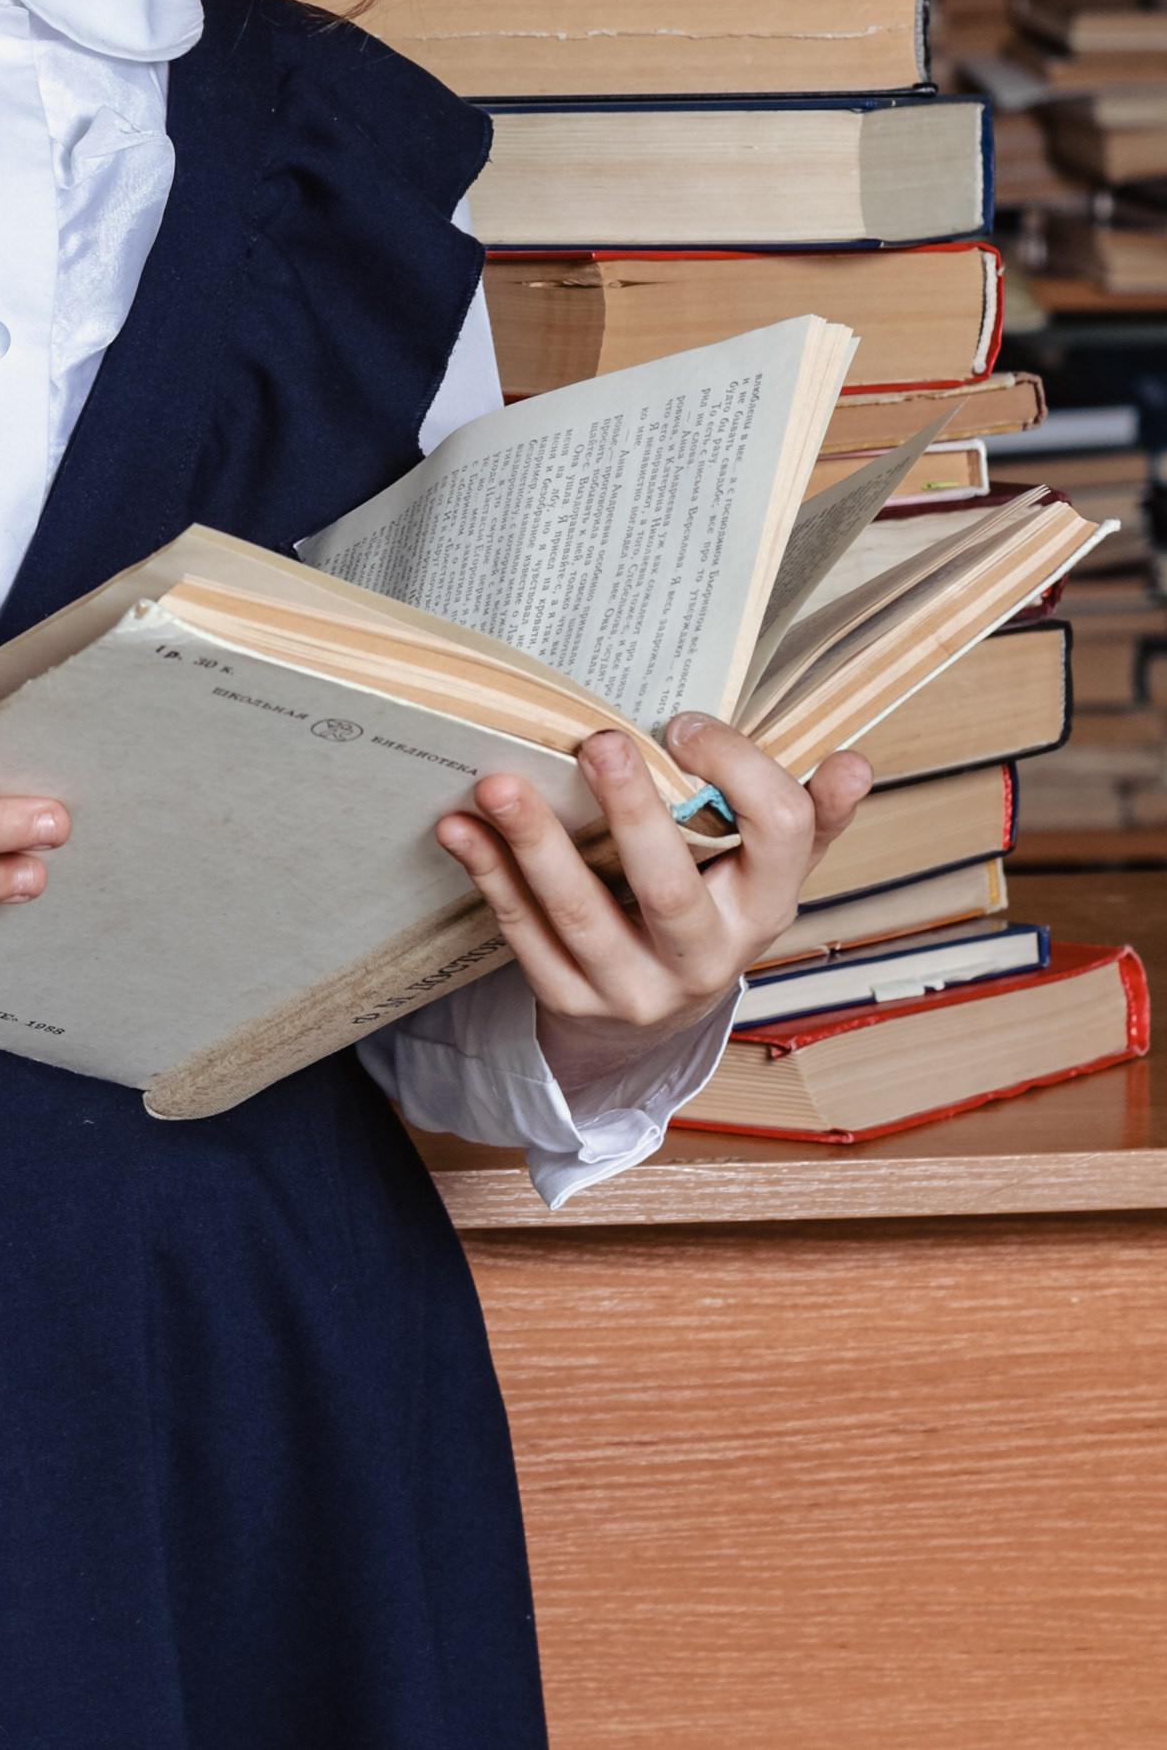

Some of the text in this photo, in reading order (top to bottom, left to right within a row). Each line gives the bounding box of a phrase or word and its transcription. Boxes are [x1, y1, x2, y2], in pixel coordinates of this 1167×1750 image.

[663, 398, 673, 418] что
[699, 387, 711, 407] рил
[709, 401, 722, 417] То
[722, 380, 739, 412] будто
[737, 391, 746, 403] не
[743, 373, 762, 429] влюблены
[639, 406, 649, 420] ко
[669, 394, 685, 439] ровича,
[695, 412, 704, 426] ни
[717, 417, 729, 432] бы
[560, 428, 573, 456] меня
[595, 417, 611, 463] просить
[658, 422, 668, 442] его
[677, 430, 691, 459] Анна
[702, 420, 714, 445] есть
[725, 410, 743, 451] бывать
[548, 432, 561, 459] меня
[570, 443, 584, 467] Она
[488, 450, 501, 483] уходе
[527, 435, 548, 493] например,
[555, 465, 565, 478] на
[614, 449, 630, 478] Анна
[633, 436, 653, 501] ненавистно
[499, 443, 524, 531] выздоровления
[510, 438, 538, 520] безотчетному,
[640, 446, 663, 513] оправдают,
[654, 455, 675, 512] Катерина
[690, 460, 705, 502] письма
[457, 472, 478, 536] Бьорингом
[493, 494, 501, 508] то
[524, 496, 533, 509] не
[545, 488, 559, 512] лбу,
[581, 468, 600, 523] побывать
[590, 465, 612, 539] проговорила
[662, 465, 684, 527] Андреевна
[467, 507, 478, 536] меня
[527, 477, 552, 548] безобразное
[542, 520, 551, 534] но
[600, 483, 622, 545] Андреевна
[706, 514, 716, 533] все
[482, 516, 497, 564] смутное
[510, 512, 529, 574] наполнило
[619, 505, 638, 558] поглядел
[630, 529, 644, 559] того,
[657, 531, 667, 549] уж
[711, 498, 732, 566] господином
[490, 547, 501, 576] моей
[498, 533, 514, 583] которым
[546, 530, 562, 569] присел
[570, 541, 583, 565] ней,
[583, 545, 594, 566] она
[635, 516, 661, 587] Николаевна
[650, 554, 661, 574] как
[699, 541, 711, 562] про
[462, 543, 484, 606] Егоровны,
[514, 554, 532, 604] известие
[541, 577, 551, 591] на
[586, 549, 605, 601] особенно
[615, 563, 624, 577] на
[695, 568, 704, 582] то
[472, 573, 486, 613] первое
[482, 592, 492, 615] ним
[502, 577, 515, 606] меня
[521, 559, 542, 624] чувствовал
[561, 570, 577, 610] только
[571, 572, 588, 611] совсем
[607, 563, 638, 639] Стебелькова,
[662, 589, 675, 614] весь
[694, 569, 719, 632] Бьорингом
[599, 607, 614, 631] Она
[632, 578, 655, 634] сожалеют
[526, 597, 546, 648] кровати,
[541, 623, 552, 644] так
[555, 615, 566, 635] что
[567, 605, 590, 665] приказали
[549, 640, 559, 656] вы
[556, 617, 576, 667] шепотом
[587, 635, 604, 674] встала
[625, 640, 637, 661] про
[642, 618, 667, 679] задрожал,
[193, 657, 218, 669] 30
[611, 651, 622, 670] все
[604, 675, 616, 696] про
[614, 666, 630, 698] князя
[638, 682, 648, 696] но
[675, 658, 691, 697] совсем
[632, 700, 642, 713] не
[656, 688, 670, 714] того
[212, 686, 478, 777] ШКОЛЬНАЯ БИБЛИОТЕКА
[25, 1019, 65, 1036] 1988
